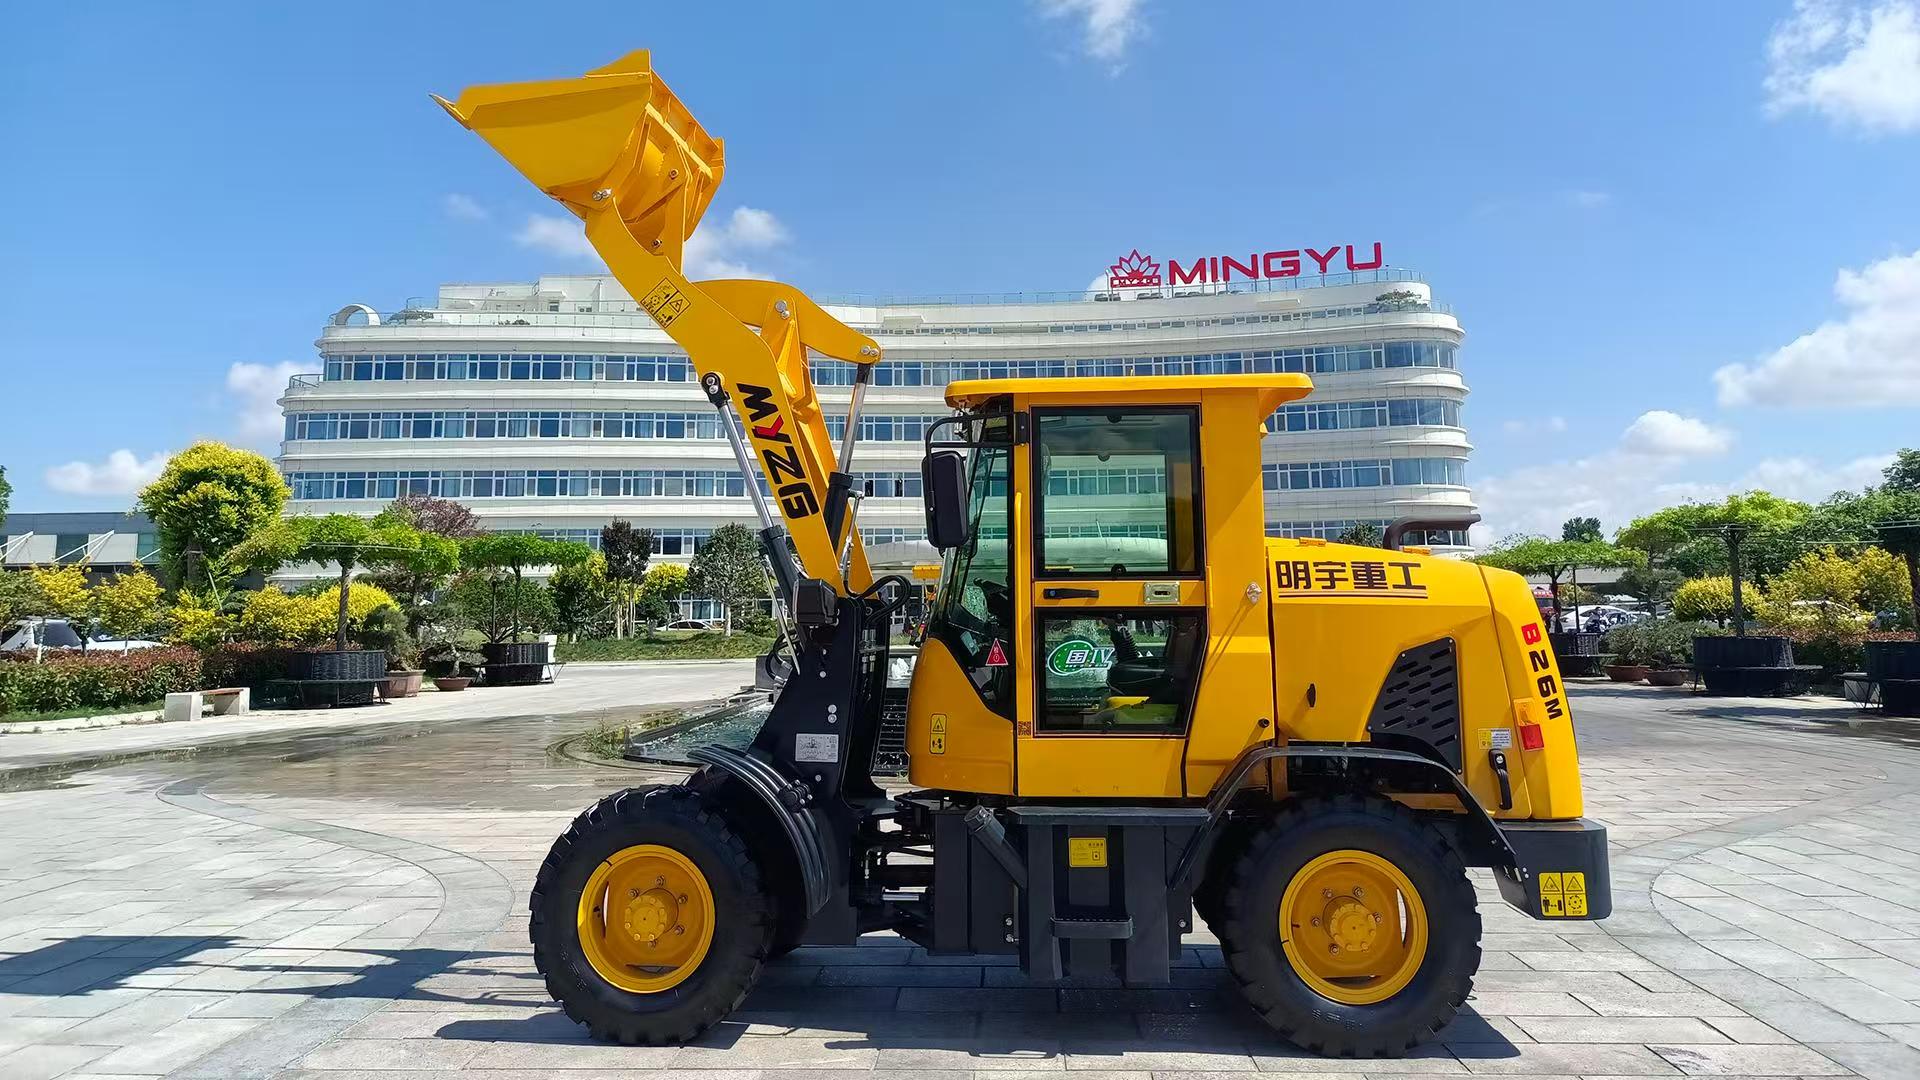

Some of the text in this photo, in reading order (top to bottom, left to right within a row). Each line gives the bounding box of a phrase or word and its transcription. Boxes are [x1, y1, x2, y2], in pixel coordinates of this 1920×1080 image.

[1168, 241, 1383, 286] MINGYU
[736, 382, 820, 520] MYZG
[1275, 560, 1428, 590] 明宇重工
[1520, 622, 1563, 720] B26M
